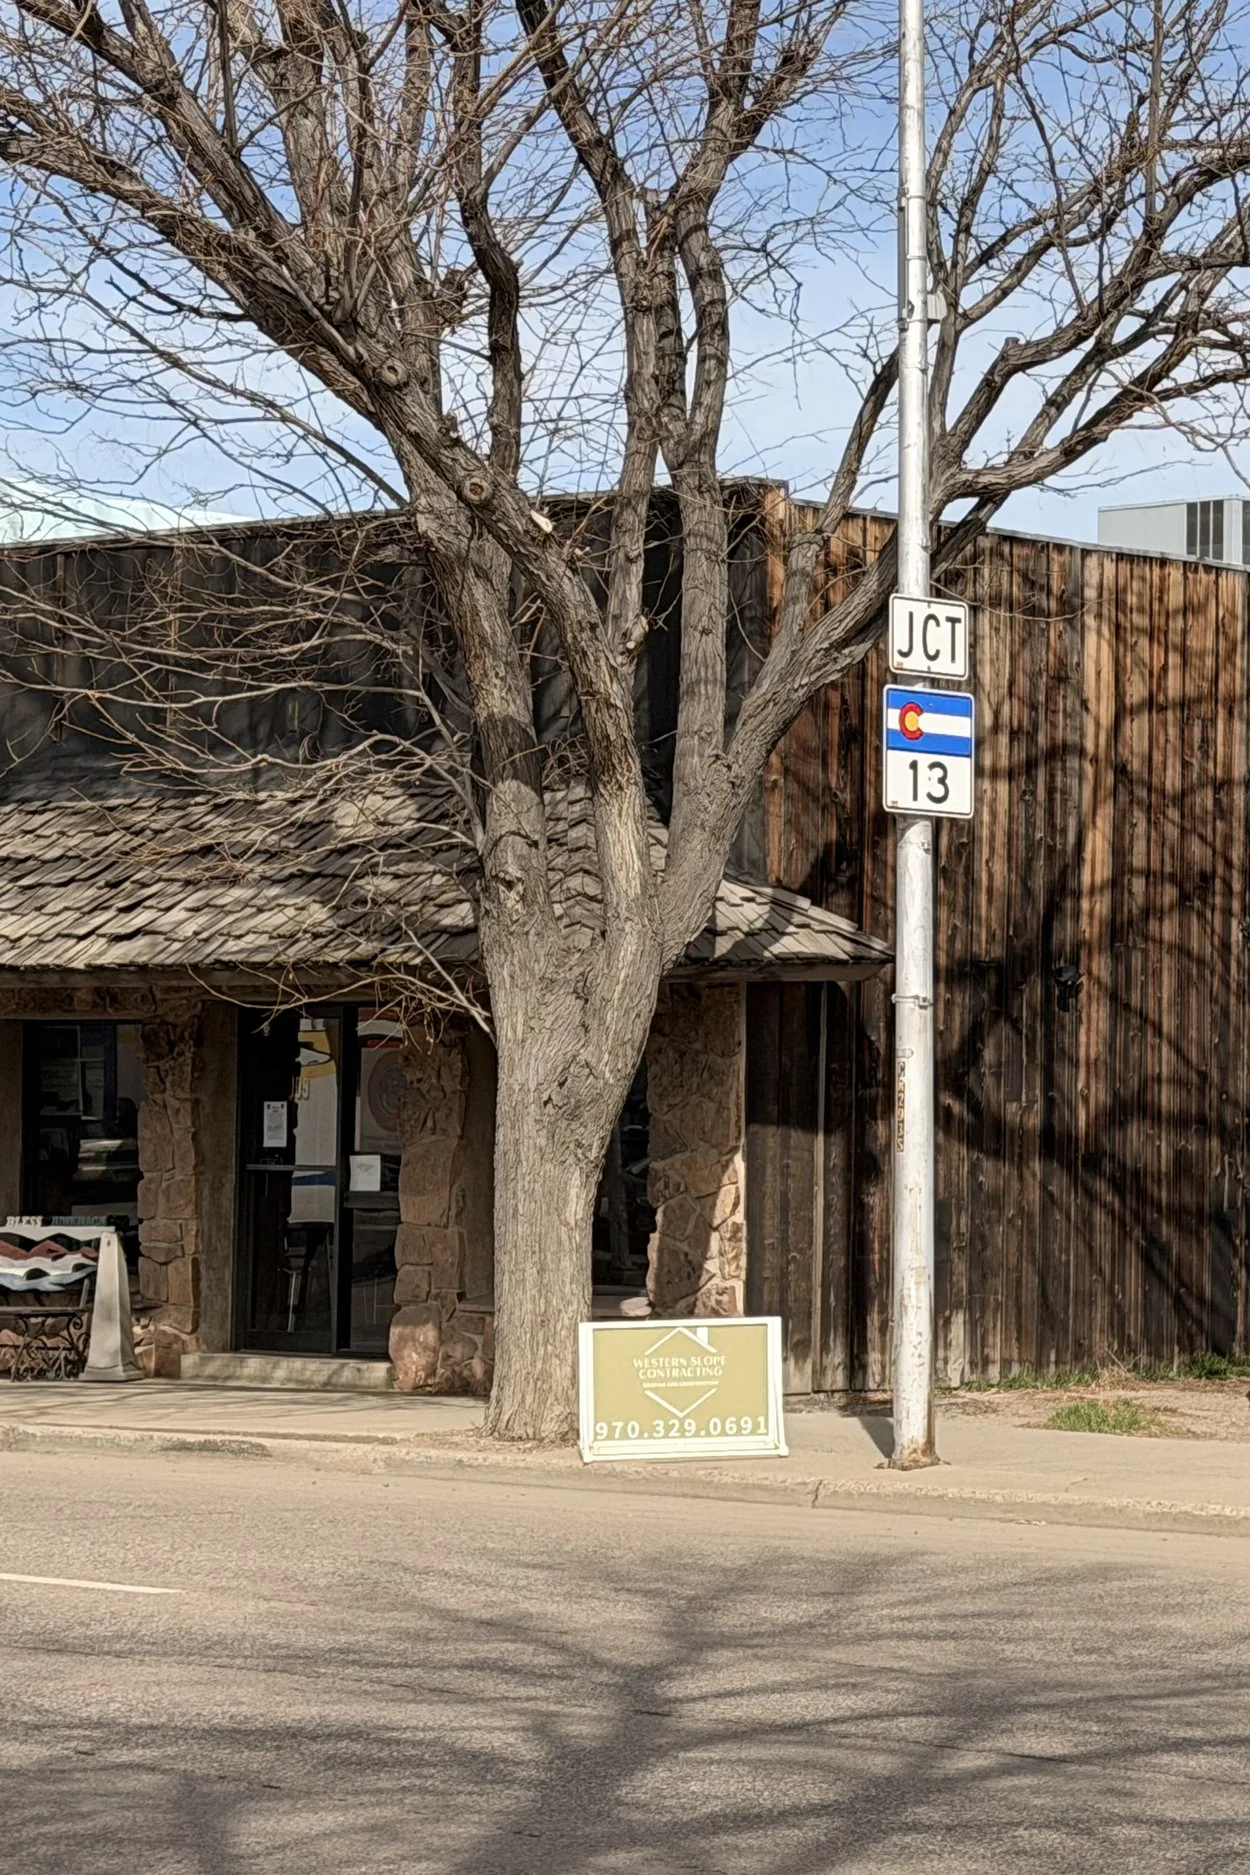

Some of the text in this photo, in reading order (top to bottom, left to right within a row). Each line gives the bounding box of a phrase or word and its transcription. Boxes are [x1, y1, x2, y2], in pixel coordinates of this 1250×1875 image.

[897, 611, 962, 664] JCT
[909, 759, 949, 804] 13
[632, 1355, 726, 1369] WESTERN SLOPE
[638, 1366, 723, 1379] CONTRACTING
[595, 1415, 768, 1440] 970.329.0691
